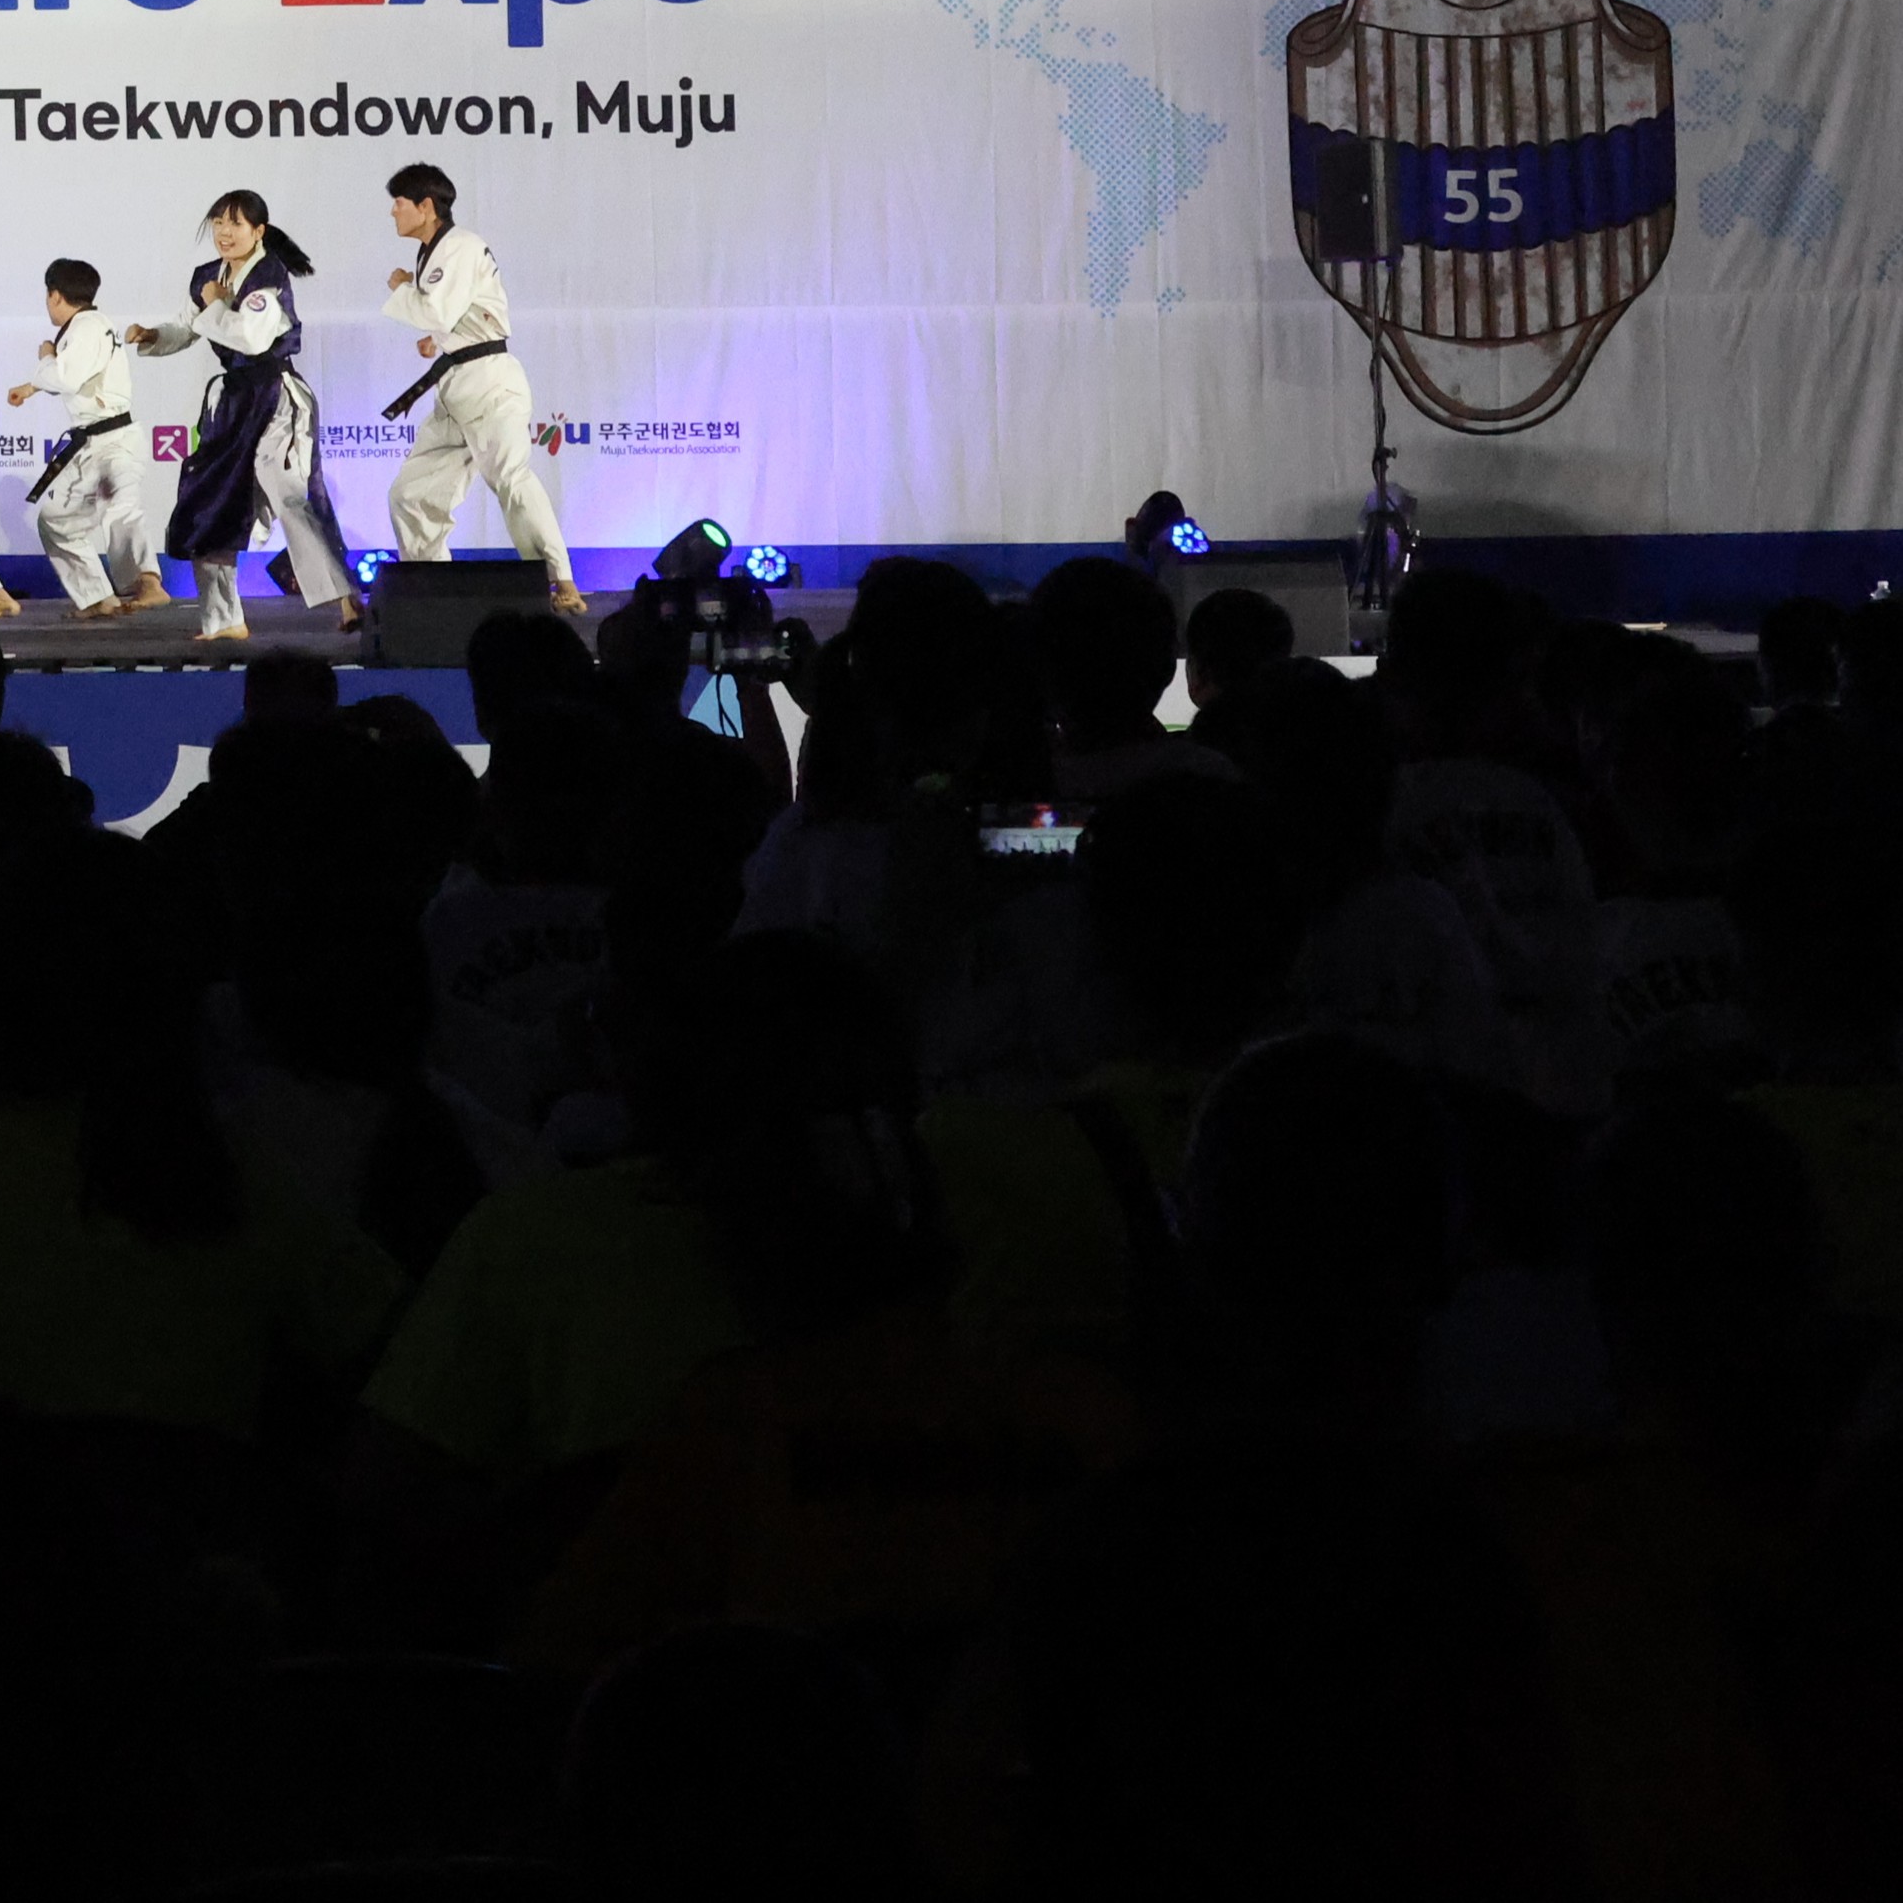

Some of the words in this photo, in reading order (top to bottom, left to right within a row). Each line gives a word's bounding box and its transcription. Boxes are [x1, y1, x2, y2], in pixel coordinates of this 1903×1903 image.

[576, 76, 736, 149] Muju
[1443, 167, 1524, 224] 55
[598, 420, 740, 442] 무주군태권도협회
[325, 449, 358, 459] STATE
[360, 448, 400, 458] SPORTS
[600, 445, 625, 457] Muju
[627, 445, 682, 455] Taekwondo
[685, 444, 740, 455] Association
